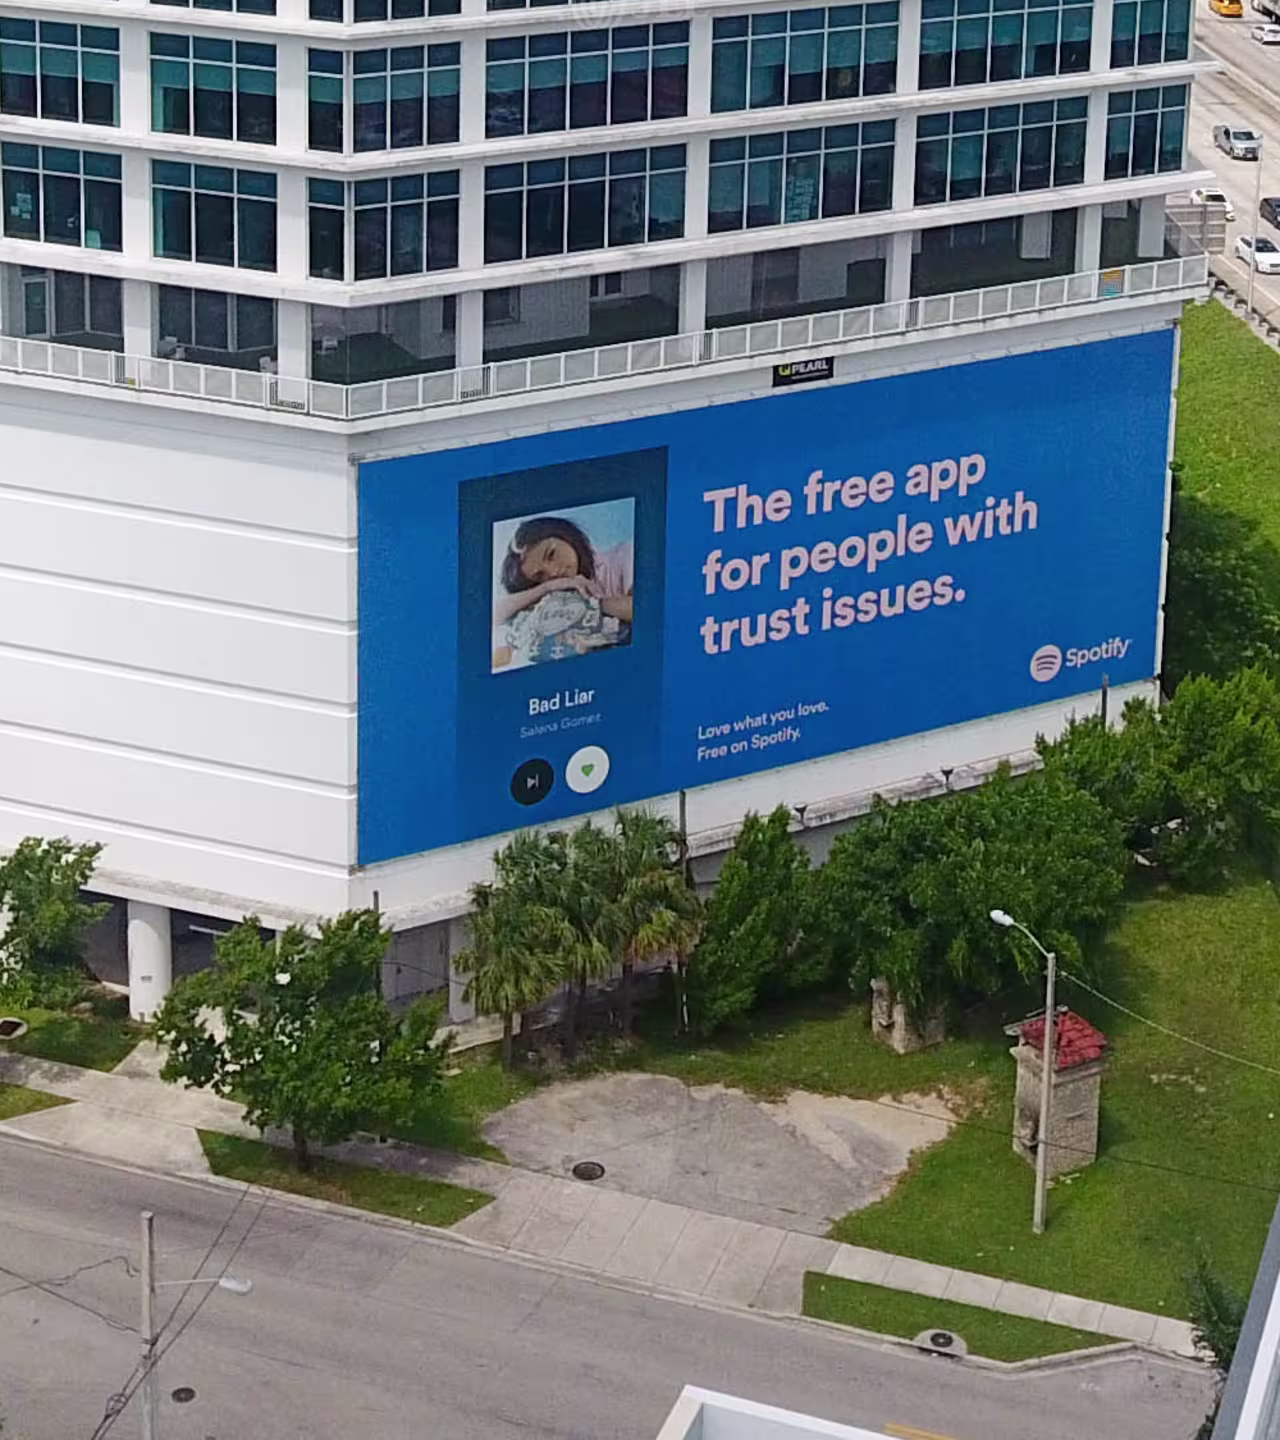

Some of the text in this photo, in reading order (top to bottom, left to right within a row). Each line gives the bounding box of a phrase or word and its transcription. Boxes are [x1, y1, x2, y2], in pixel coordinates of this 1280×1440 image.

[791, 359, 829, 375] PEARL
[703, 453, 986, 533] The free app
[702, 491, 1038, 595] for people with
[699, 575, 966, 655] trust issues.
[1065, 636, 1129, 668] Spotify
[529, 688, 595, 716] Bad Liar
[698, 700, 830, 740] Love what you love.
[697, 745, 729, 762] Free
[730, 740, 748, 754] on
